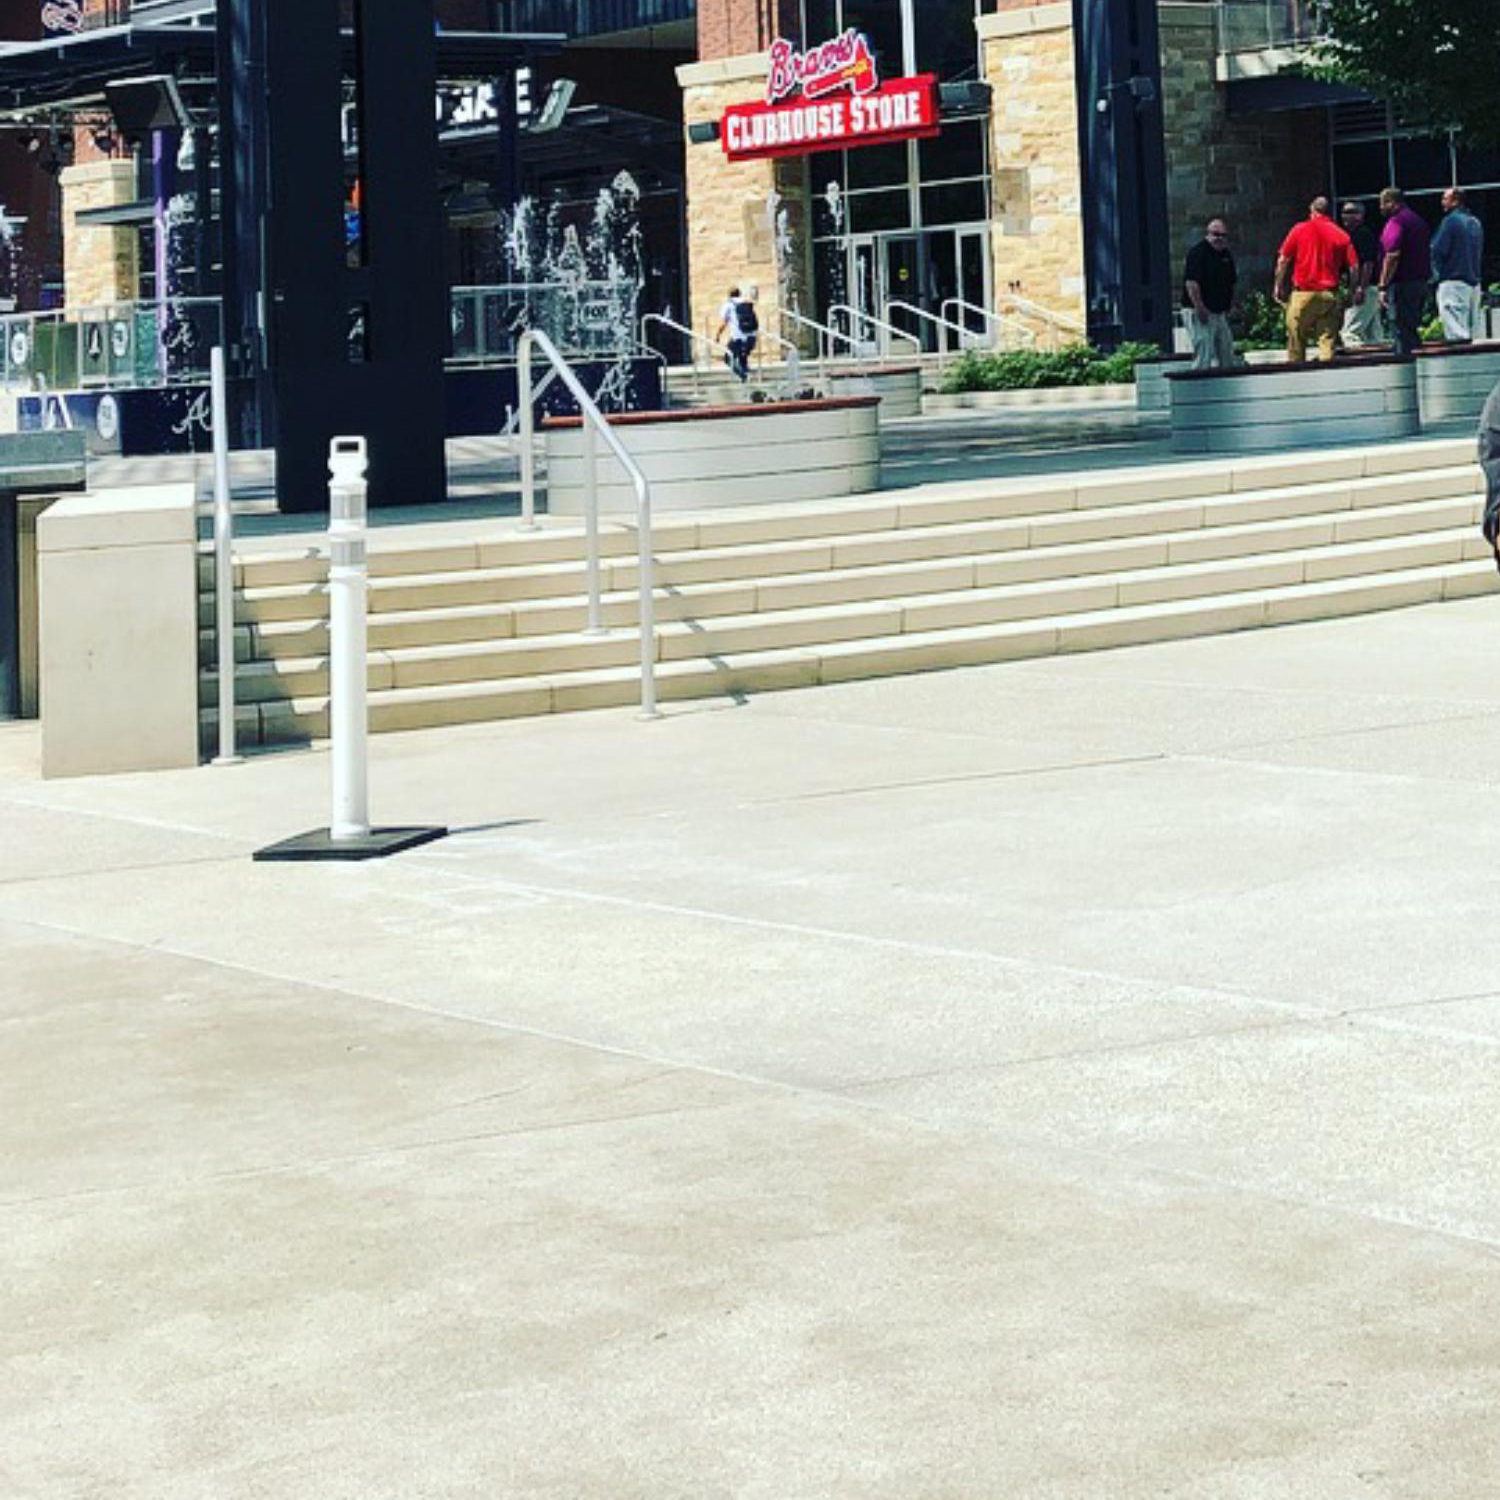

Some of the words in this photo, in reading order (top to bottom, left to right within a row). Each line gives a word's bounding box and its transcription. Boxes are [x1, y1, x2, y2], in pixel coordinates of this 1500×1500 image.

[767, 27, 857, 105] Braves
[726, 101, 846, 151] CLUBHOUSE
[850, 90, 921, 134] STORE
